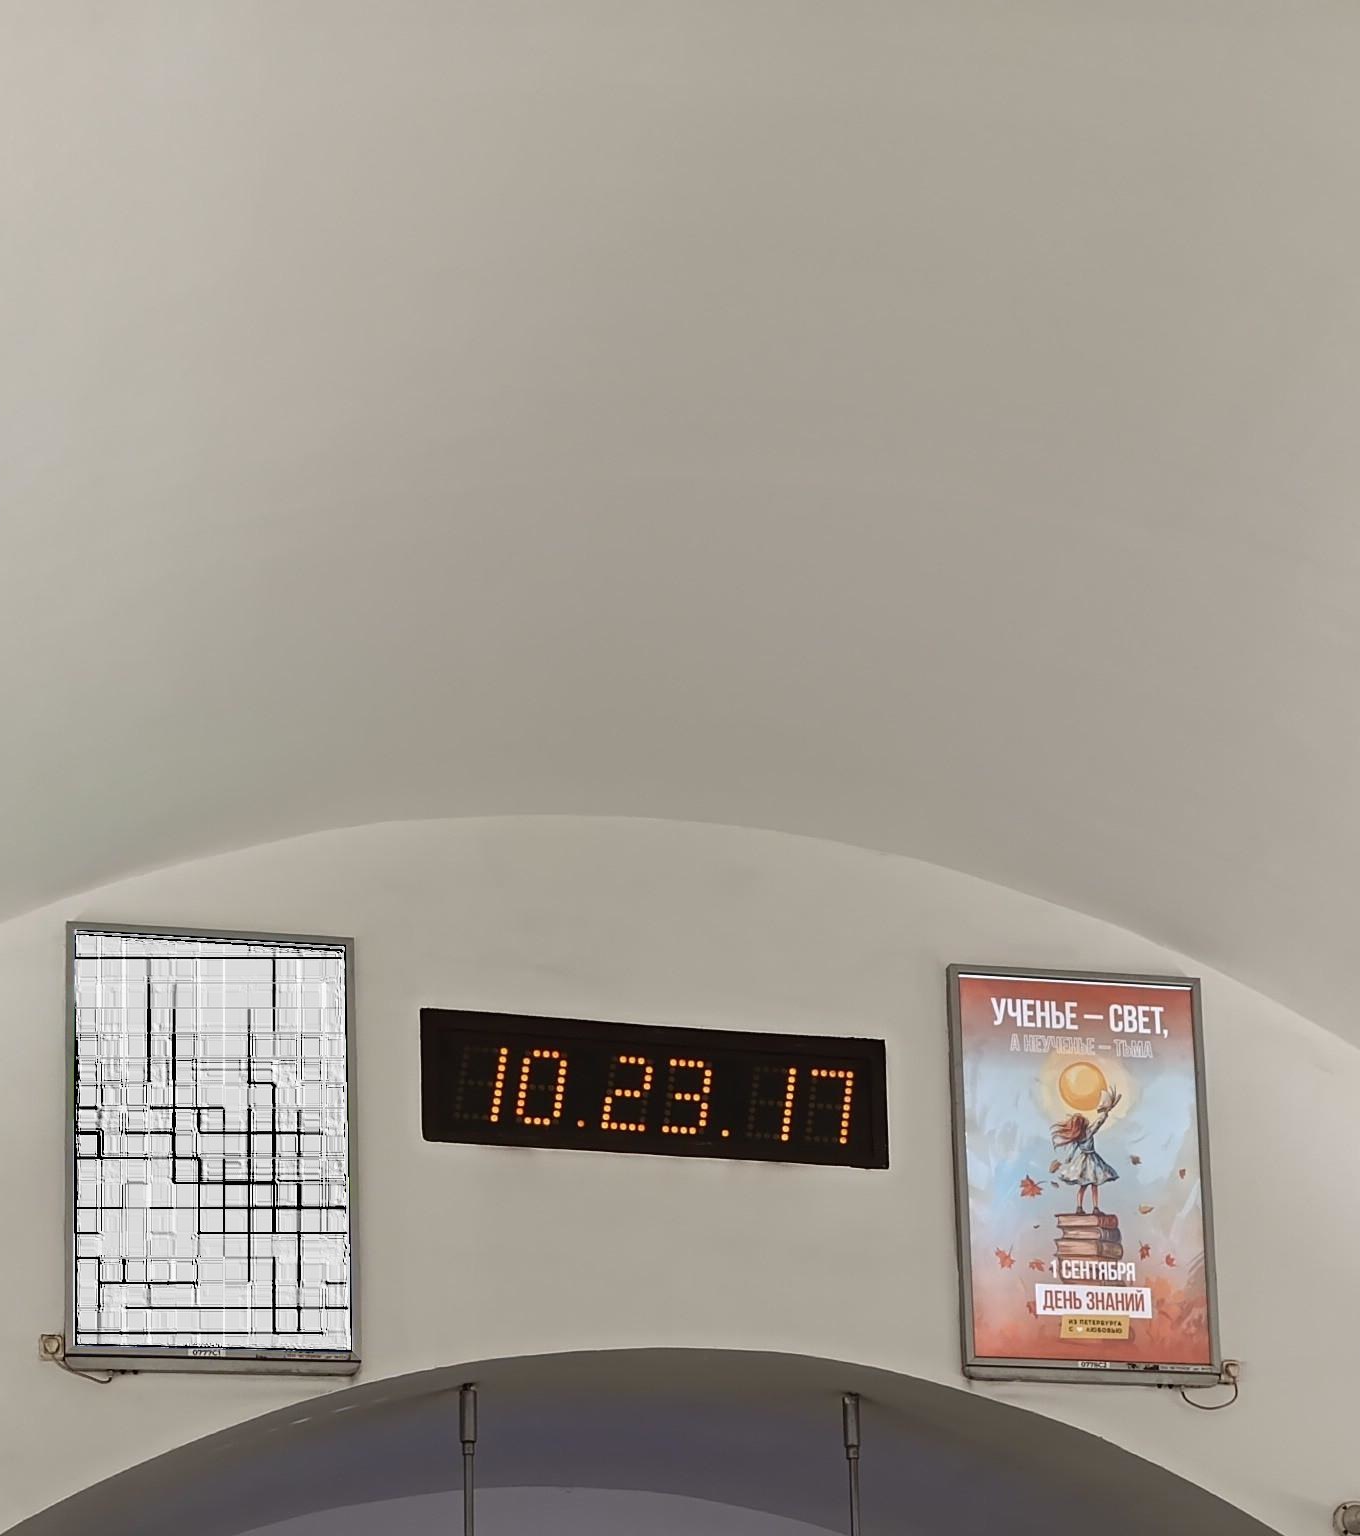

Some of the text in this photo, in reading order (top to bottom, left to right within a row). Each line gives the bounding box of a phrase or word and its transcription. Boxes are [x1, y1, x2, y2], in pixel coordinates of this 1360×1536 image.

[990, 997, 1079, 1030] УЧЕНЬЕ
[1108, 1003, 1169, 1039] СВЕТ,
[1010, 1033, 1020, 1052] А
[1023, 1034, 1096, 1056] НЕУЧЕНЬЕ
[1113, 1039, 1153, 1059] ТЬМА
[489, 1046, 856, 1146] 10.23.17
[1050, 1260, 1136, 1281] 1 СЕНТЯБРЯ
[1042, 1289, 1145, 1312] ДЕНЬ ЗНАНИЙ
[1079, 1319, 1123, 1327] ПЕТЕРБУРГА
